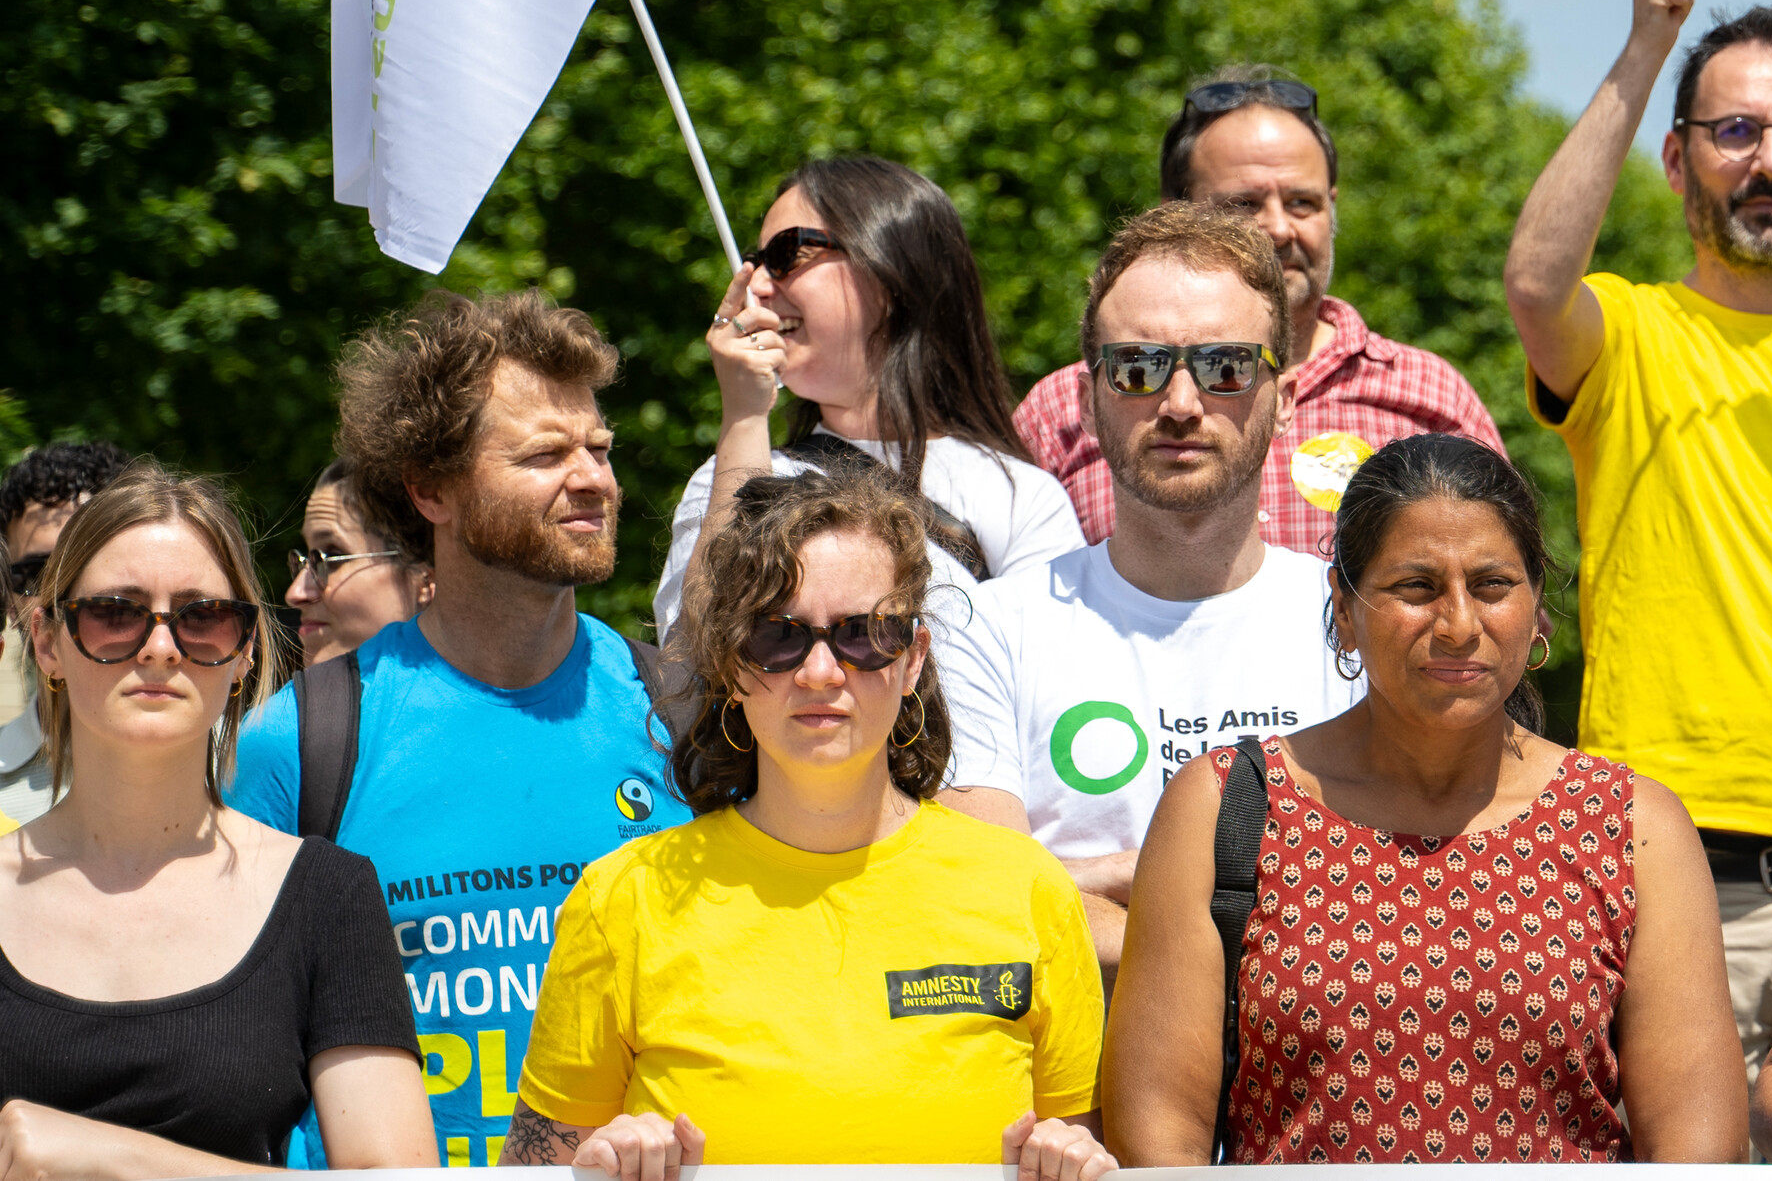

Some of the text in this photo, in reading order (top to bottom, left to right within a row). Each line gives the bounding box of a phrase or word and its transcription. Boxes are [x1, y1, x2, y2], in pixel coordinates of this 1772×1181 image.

[1158, 705, 1299, 735] Les Amis
[1160, 739, 1192, 765] de
[617, 824, 662, 834] FAIRTRADE
[388, 864, 534, 906] MILITONS
[393, 905, 566, 958] COMM
[405, 962, 550, 1018] MON
[901, 975, 981, 997] AMNESTY
[902, 993, 986, 1008] INTERNATIONAL
[416, 1029, 520, 1118] PL
